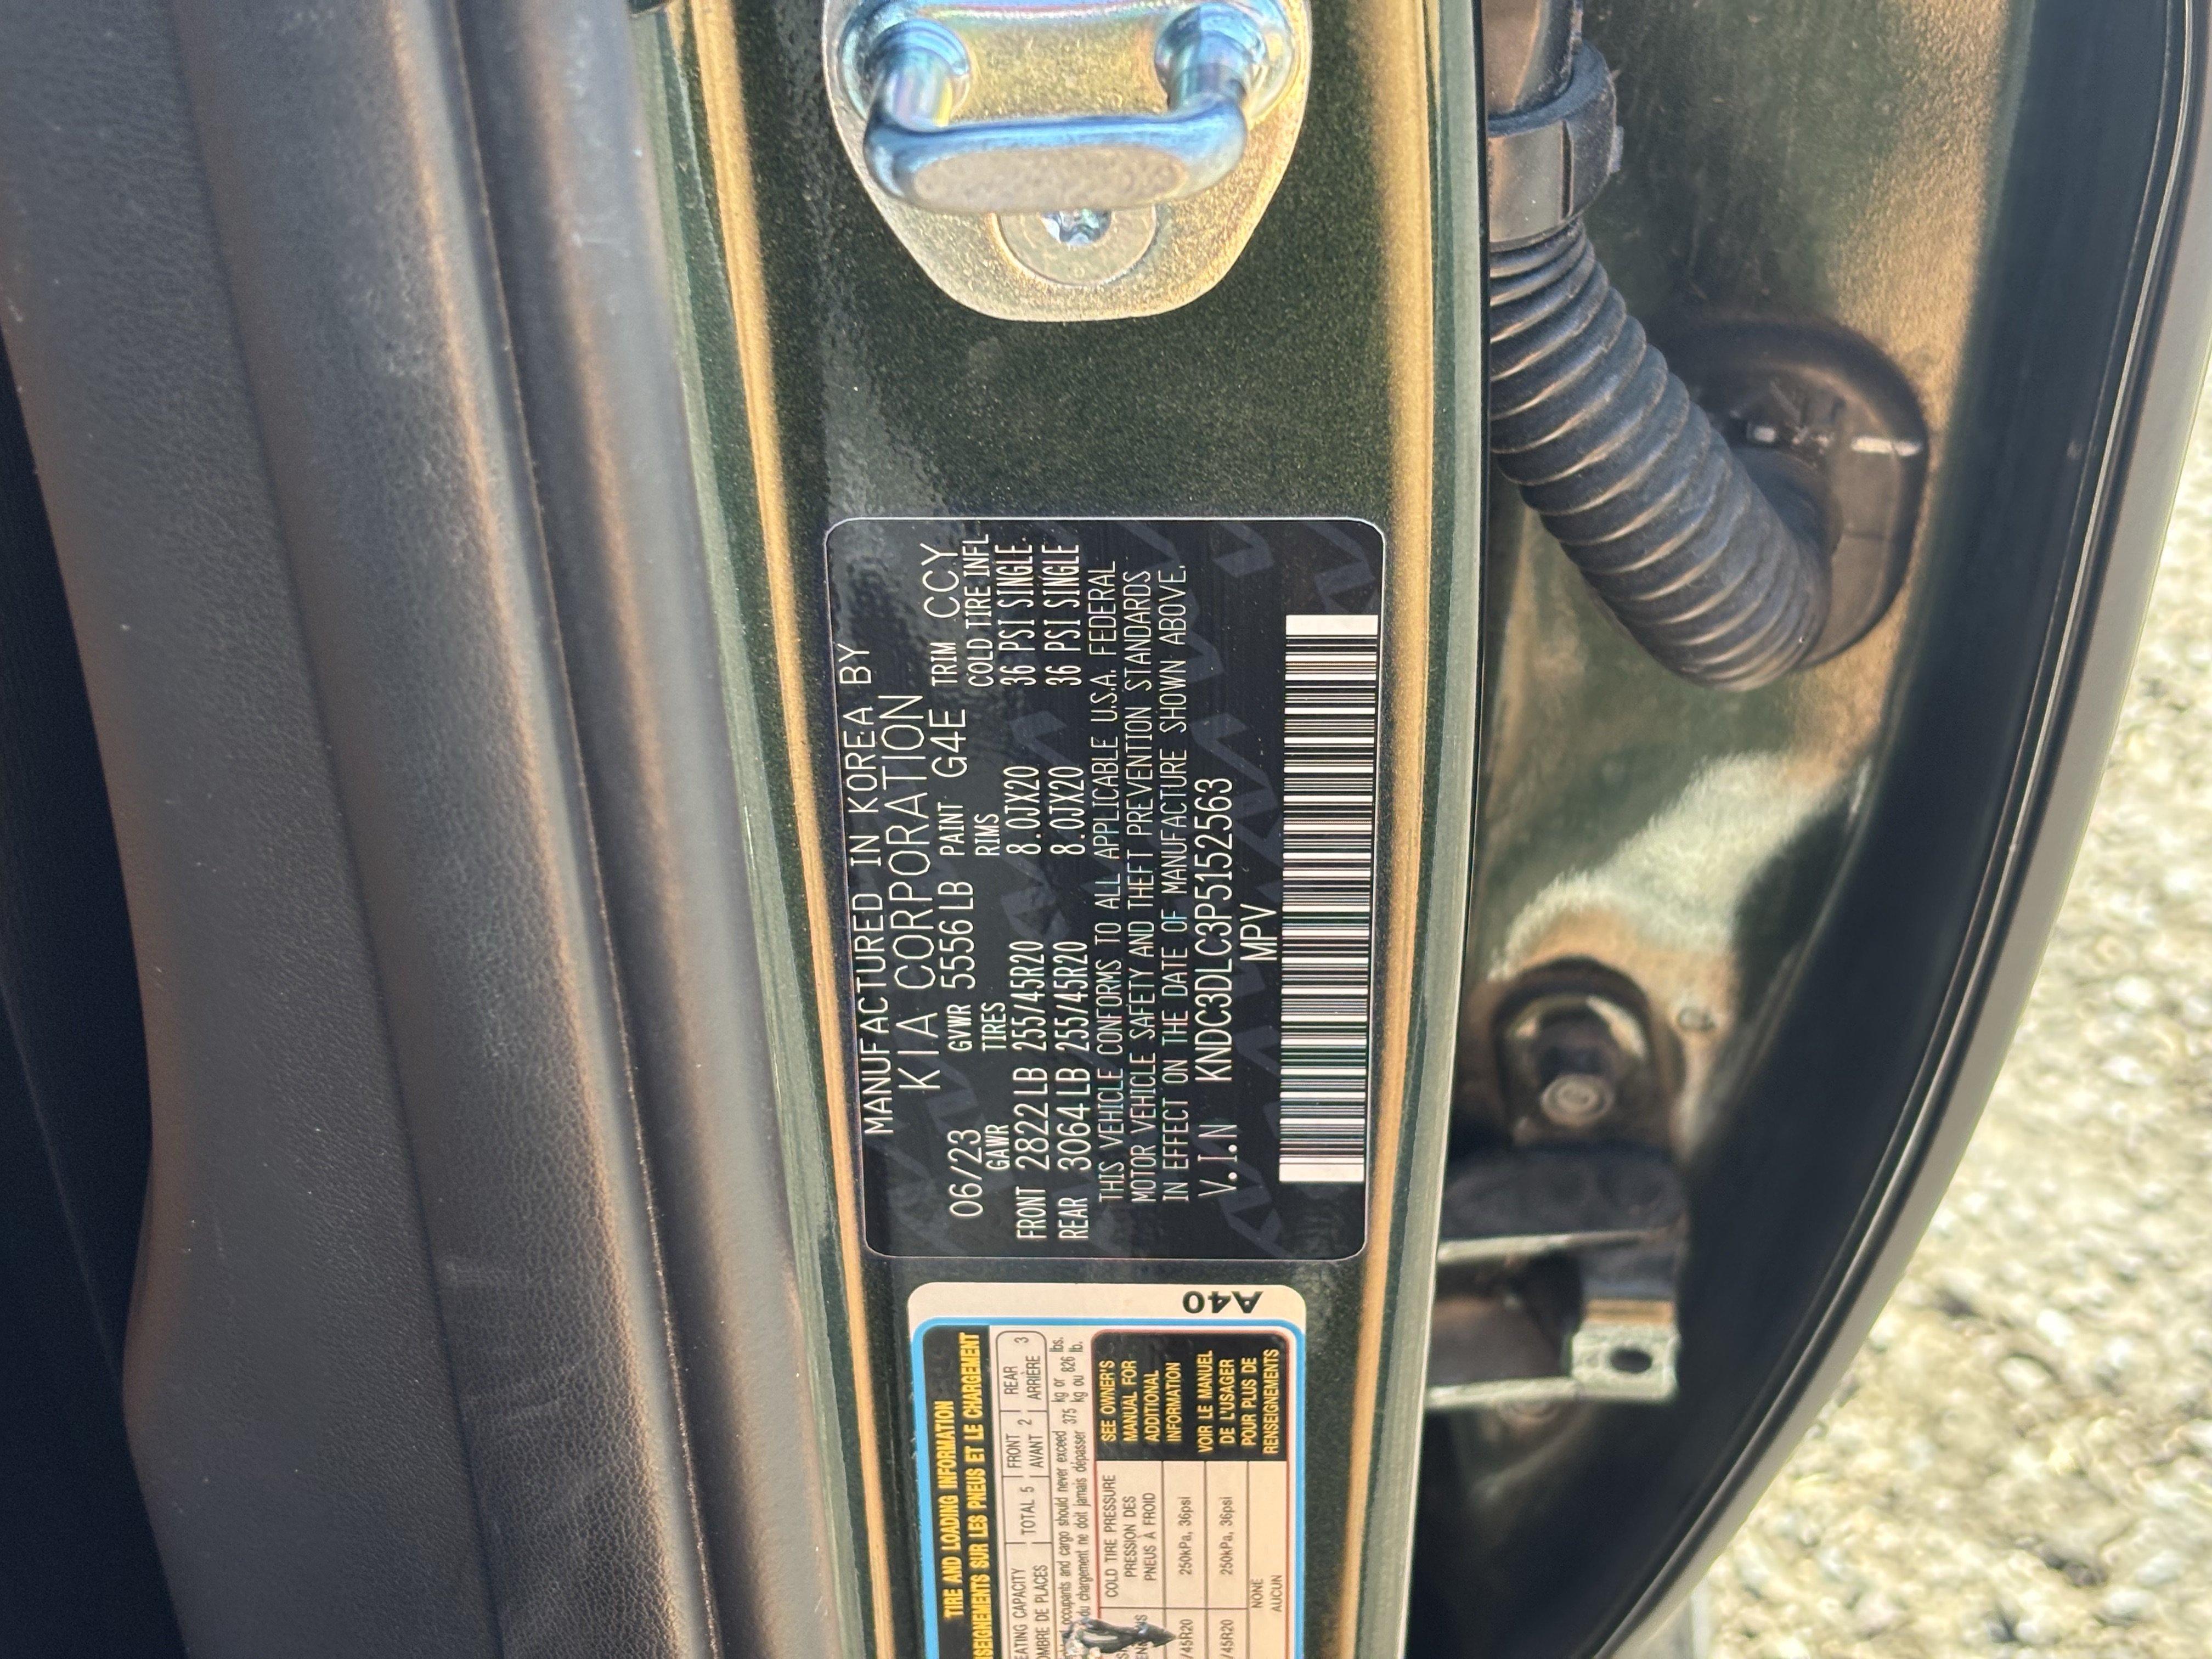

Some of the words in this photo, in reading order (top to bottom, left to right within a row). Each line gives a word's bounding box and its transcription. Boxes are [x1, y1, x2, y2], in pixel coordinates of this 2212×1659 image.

[962, 534, 990, 577] INFL
[920, 543, 961, 618] CCY
[995, 545, 1035, 608] SINGLE
[1041, 545, 1080, 608] SINGLE
[964, 586, 991, 629] TIRE
[1087, 561, 1116, 655] FEDERAL
[1158, 564, 1186, 645] ABOVE.
[997, 619, 1035, 651] PSI
[1043, 619, 1081, 651] PSI
[1123, 571, 1153, 691] STANDARDS
[838, 643, 872, 684] BY
[930, 642, 958, 686] TRIM
[968, 639, 994, 686] COLD
[999, 665, 1036, 686] 36
[1045, 665, 1082, 686] 36
[1090, 670, 1118, 722] U.S.A.
[1159, 659, 1187, 733] SHOWN
[843, 707, 878, 813] KOREA
[929, 709, 967, 777] G4E
[1125, 707, 1153, 836] PREVENTION
[1003, 766, 1041, 854] 8.0JX20
[1047, 766, 1086, 854] 8.0JX20
[1091, 736, 1120, 860] APPLICABLE
[938, 802, 964, 855] PAINT
[974, 814, 1000, 855] RIMS
[1159, 748, 1187, 893] MANUFACTURE
[849, 836, 881, 866] IN
[878, 695, 935, 989] CORPORATION
[938, 881, 974, 910] LB
[1094, 873, 1121, 910] ALL
[1127, 848, 1154, 910] THEFT
[1094, 922, 1122, 944] TO
[1128, 921, 1154, 957] AND
[1161, 910, 1188, 933] OF
[1194, 778, 1233, 1082] KNDC3DLC3P5152563
[1240, 904, 1277, 962] MPV
[939, 920, 976, 990] 5556
[1161, 947, 1188, 997] DATE
[851, 893, 894, 1135] MANUFACTURED
[1009, 941, 1047, 1051] 255/45R20
[1052, 941, 1090, 1051] 255/45R20
[1094, 960, 1123, 1055] CONFORMS
[1128, 969, 1155, 1040] SAFETY
[946, 1005, 972, 1052] GVWR
[981, 1002, 1007, 1051] TIRES
[1161, 1010, 1188, 1046] THE
[895, 1013, 940, 1090] KIA
[1162, 1059, 1188, 1084] ON
[1013, 1068, 1048, 1095] LB
[1056, 1068, 1090, 1095] LB
[1129, 1053, 1156, 1133] VEHICLE
[1097, 1068, 1124, 1148] VEHICLE
[985, 1125, 1010, 1170] GAWR
[1013, 1102, 1049, 1170] 2822
[1056, 1103, 1091, 1170] 3064
[1161, 1097, 1189, 1169] EFFECT
[947, 1130, 984, 1217] 06/23
[1098, 1161, 1125, 1202] THIS
[1130, 1145, 1157, 1202] MOTOR
[1163, 1182, 1189, 1202] IN
[1015, 1186, 1047, 1239] FRONT
[1058, 1198, 1089, 1239] REAR
[1182, 1291, 1263, 1313] A40
[1048, 1337, 1064, 1352] lbs.
[1060, 1357, 1075, 1372] 826
[1068, 1341, 1083, 1352] lb.
[958, 1333, 983, 1418] CHARGEMENT
[1003, 1366, 1018, 1395] REAR
[1020, 1356, 1041, 1400] ARRIÈRE
[1053, 1378, 1064, 1387] or
[1073, 1375, 1084, 1386] ou
[1121, 1361, 1136, 1385] FOR
[1198, 1351, 1212, 1398] MANUEL
[1241, 1358, 1256, 1373] DE
[1051, 1392, 1069, 1402] kg
[1070, 1392, 1088, 1402] kg
[1099, 1361, 1115, 1414] OWNER'S
[1144, 1370, 1160, 1442] ADDITIONAL
[1165, 1363, 1182, 1442] INFORMATION
[1219, 1359, 1234, 1420] L'USAGER
[1242, 1379, 1256, 1408] PLUS
[1262, 1349, 1279, 1454] RENSEIGNEMENTS
[962, 1424, 984, 1440] LE
[1062, 1408, 1077, 1424] 375
[1101, 1420, 1116, 1442] SEE
[1122, 1392, 1138, 1441] MANUAL
[1198, 1406, 1212, 1419] LE
[1241, 1414, 1257, 1446] POUR
[934, 1401, 958, 1488] INFORMATION
[963, 1446, 984, 1463] ET
[1006, 1434, 1022, 1468] FRONT
[1028, 1434, 1043, 1468] AVANT
[1052, 1431, 1067, 1463] exceed
[1070, 1431, 1088, 1472] dépasser
[1198, 1426, 1213, 1452] VOIR
[1220, 1428, 1235, 1443] DE
[964, 1468, 986, 1509] PNEUS
[1056, 1468, 1068, 1492] never
[1072, 1478, 1091, 1506] jamais
[938, 1496, 961, 1551] LOADING
[1020, 1500, 1036, 1534] TOTAL
[1054, 1497, 1068, 1526] should
[1074, 1511, 1087, 1528] doit
[1102, 1475, 1116, 1532] PRESSURE
[1122, 1496, 1136, 1517] DES
[1142, 1492, 1155, 1526] FROID
[1178, 1497, 1193, 1526] 36psi
[1220, 1497, 1234, 1526] 36psi
[966, 1515, 989, 1538] LES
[1060, 1531, 1073, 1556] cargo
[1076, 1534, 1088, 1544] ne
[941, 1556, 962, 1583] AND
[968, 1544, 990, 1568] SUR
[1056, 1561, 1070, 1577] and
[1104, 1539, 1117, 1561] TIRE
[1123, 1523, 1137, 1577] PRESSION
[1143, 1545, 1156, 1581] PNEUS
[1180, 1532, 1194, 1575] 250kPa,
[1220, 1532, 1234, 1575] 250kPa,
[1011, 1568, 1027, 1618] CAPACITY
[1033, 1565, 1048, 1603] PLACES
[1074, 1550, 1093, 1601] chargement
[1104, 1568, 1118, 1598] COLD
[1251, 1578, 1263, 1608] NONE
[1271, 1575, 1283, 1612] AUCUN
[943, 1589, 964, 1617] TIRE
[1034, 1609, 1049, 1622] DE
[1058, 1582, 1075, 1625] occupants
[1075, 1606, 1091, 1616] du
